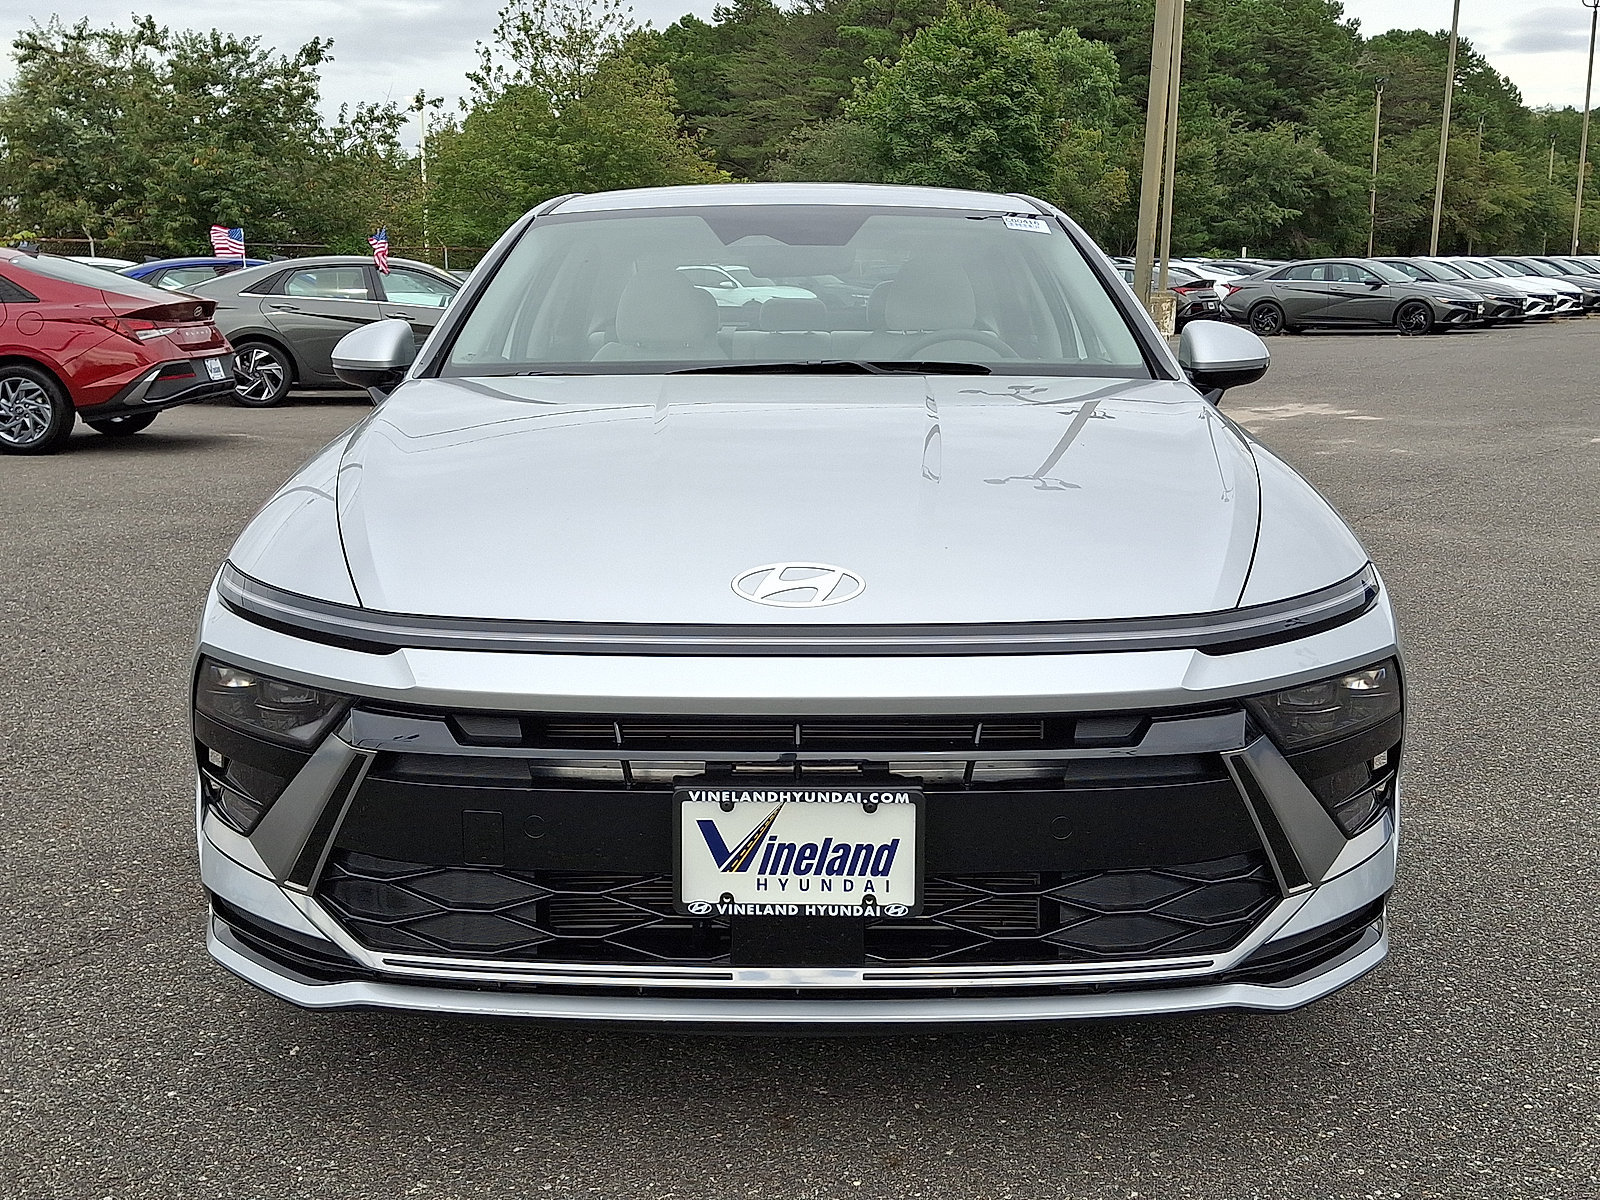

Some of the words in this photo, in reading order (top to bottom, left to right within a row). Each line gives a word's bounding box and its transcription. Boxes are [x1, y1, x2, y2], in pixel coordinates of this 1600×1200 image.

[688, 790, 910, 804] VINELANDHYUNDAI.COM
[696, 802, 901, 877] Vineland
[756, 878, 890, 893] HYUNDAI
[716, 904, 798, 916] VINELAND
[805, 904, 880, 917] HYUNDAI
